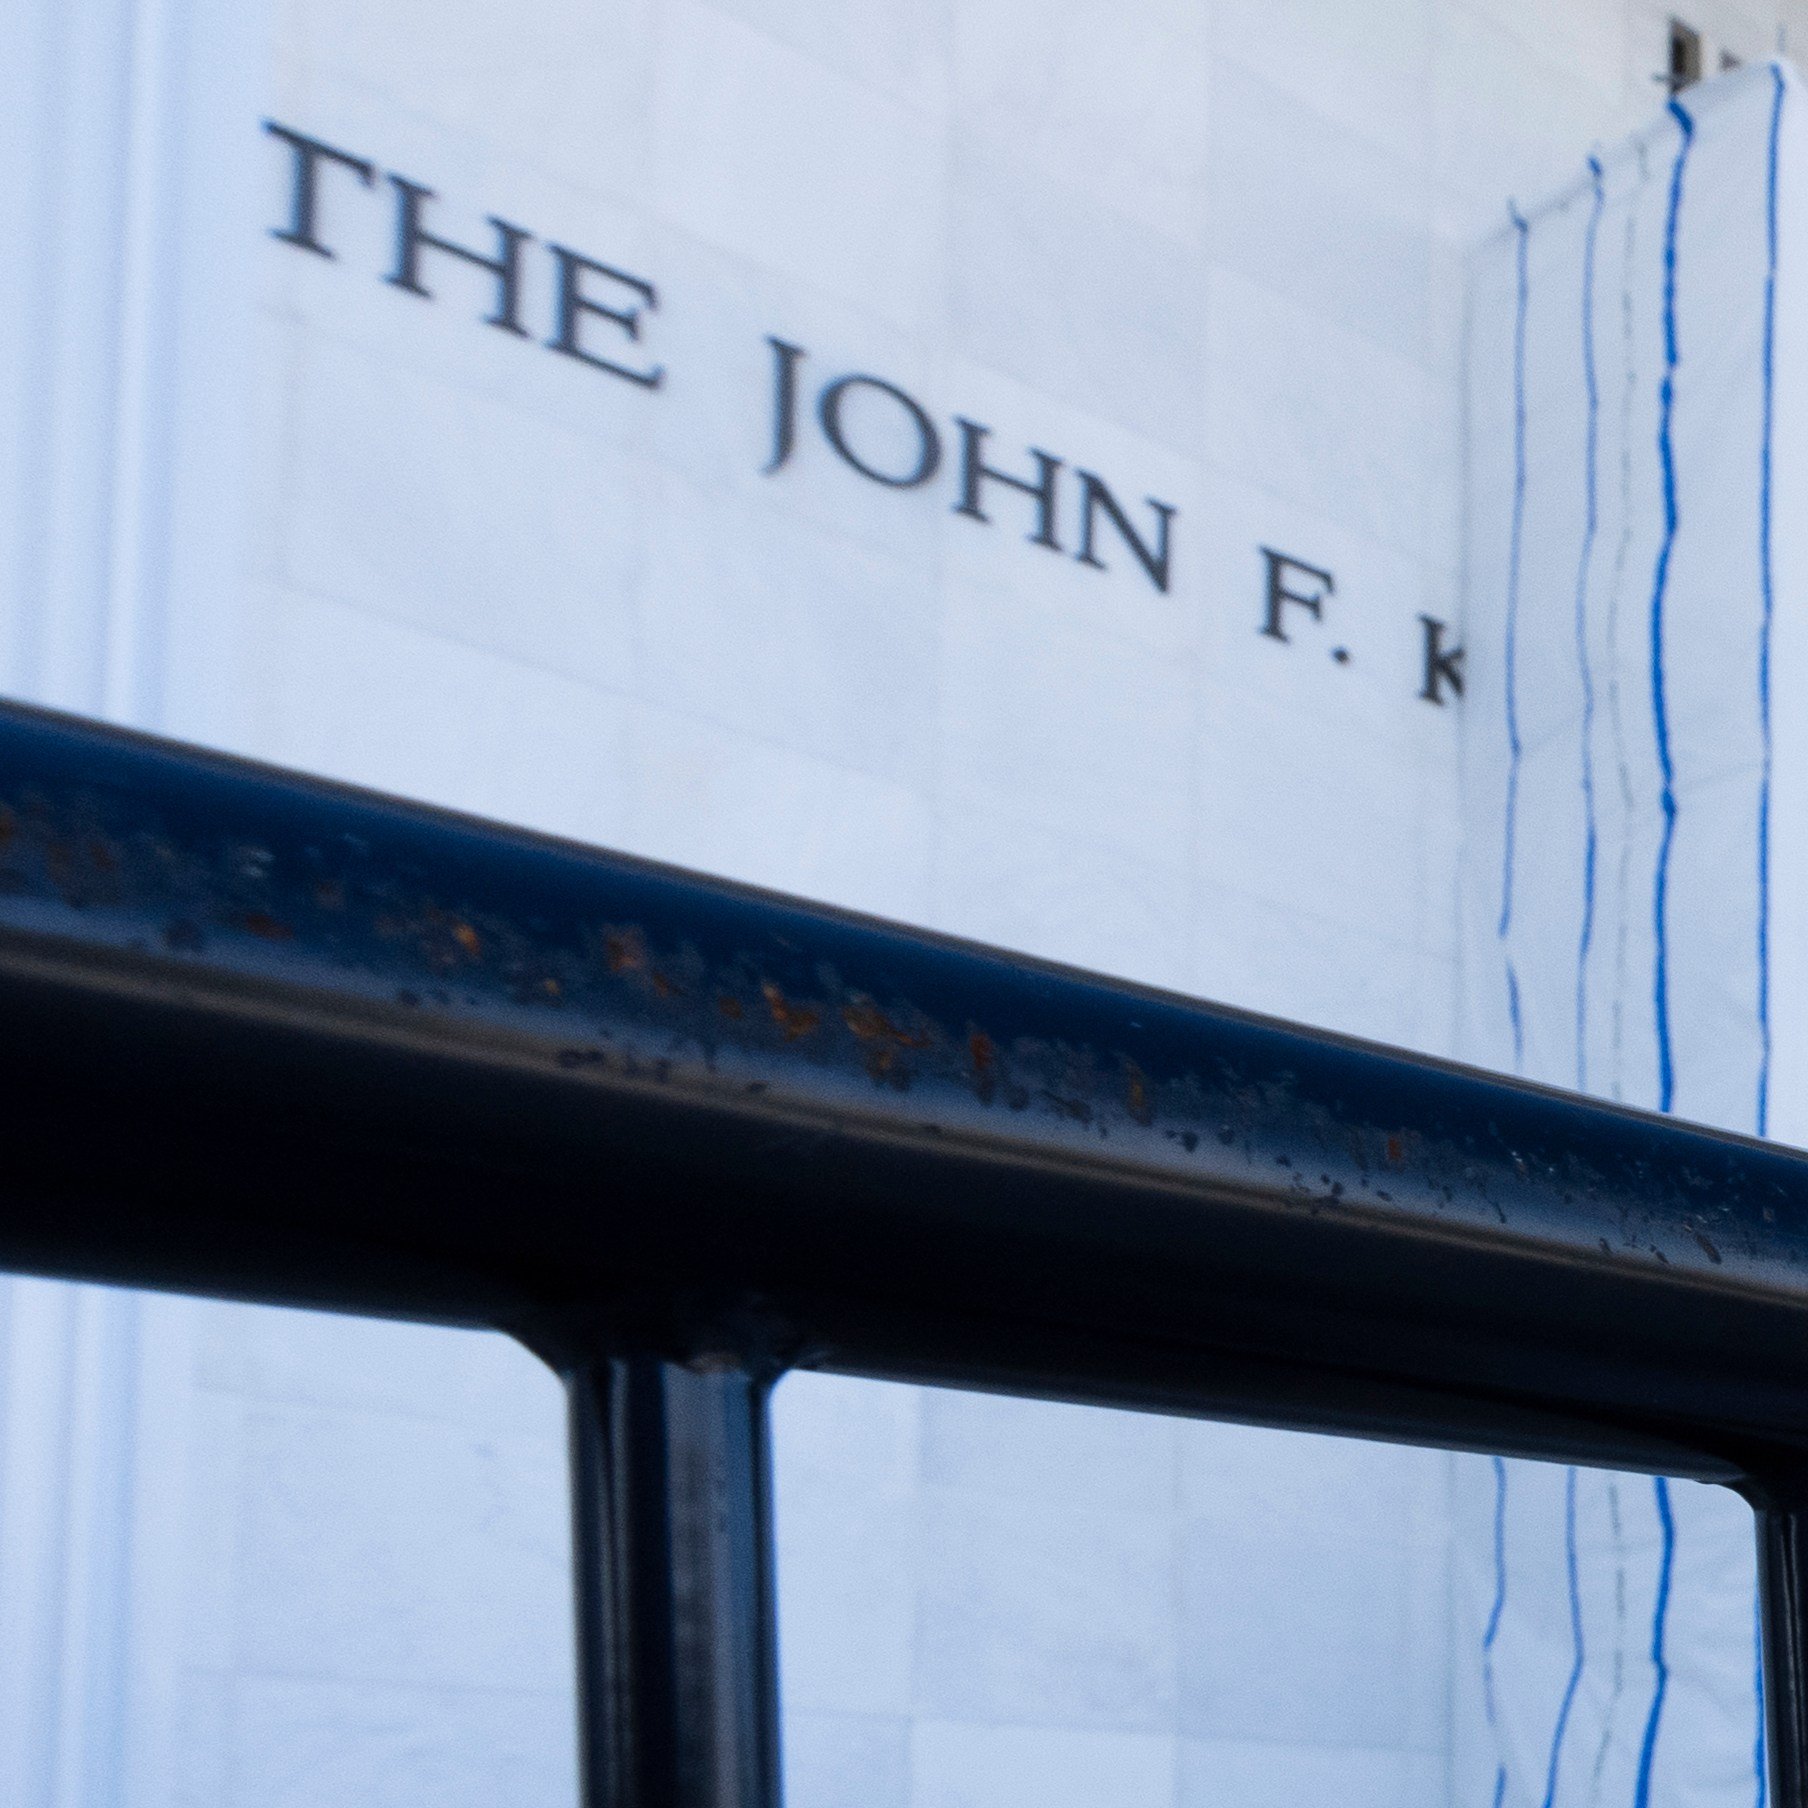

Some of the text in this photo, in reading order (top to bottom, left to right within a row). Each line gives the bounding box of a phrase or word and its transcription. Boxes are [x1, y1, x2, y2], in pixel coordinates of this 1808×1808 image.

[262, 118, 668, 392] THE
[762, 336, 1178, 596] JOHN
[1256, 547, 1351, 665] F.
